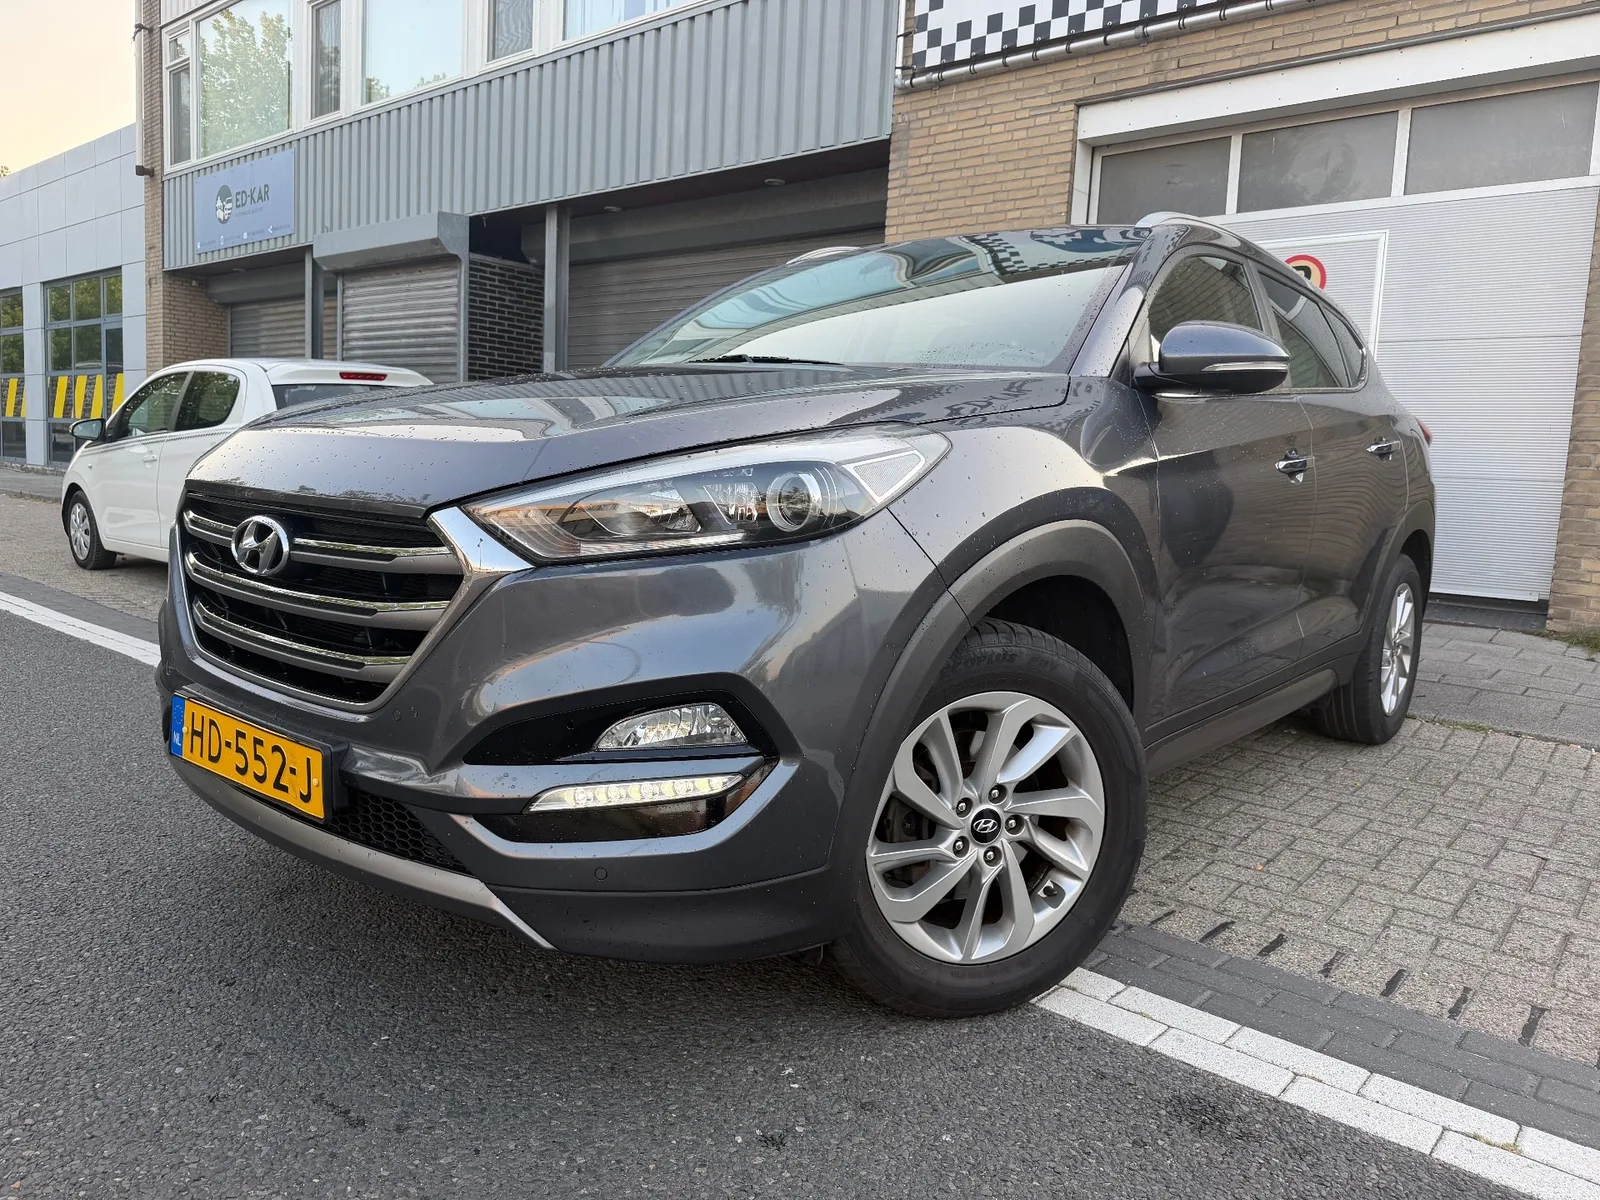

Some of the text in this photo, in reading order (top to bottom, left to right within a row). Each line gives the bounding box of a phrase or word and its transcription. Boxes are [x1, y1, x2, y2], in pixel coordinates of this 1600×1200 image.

[235, 184, 270, 209] ED-KAR
[173, 731, 182, 747] NL
[189, 711, 312, 804] HD-552-J
